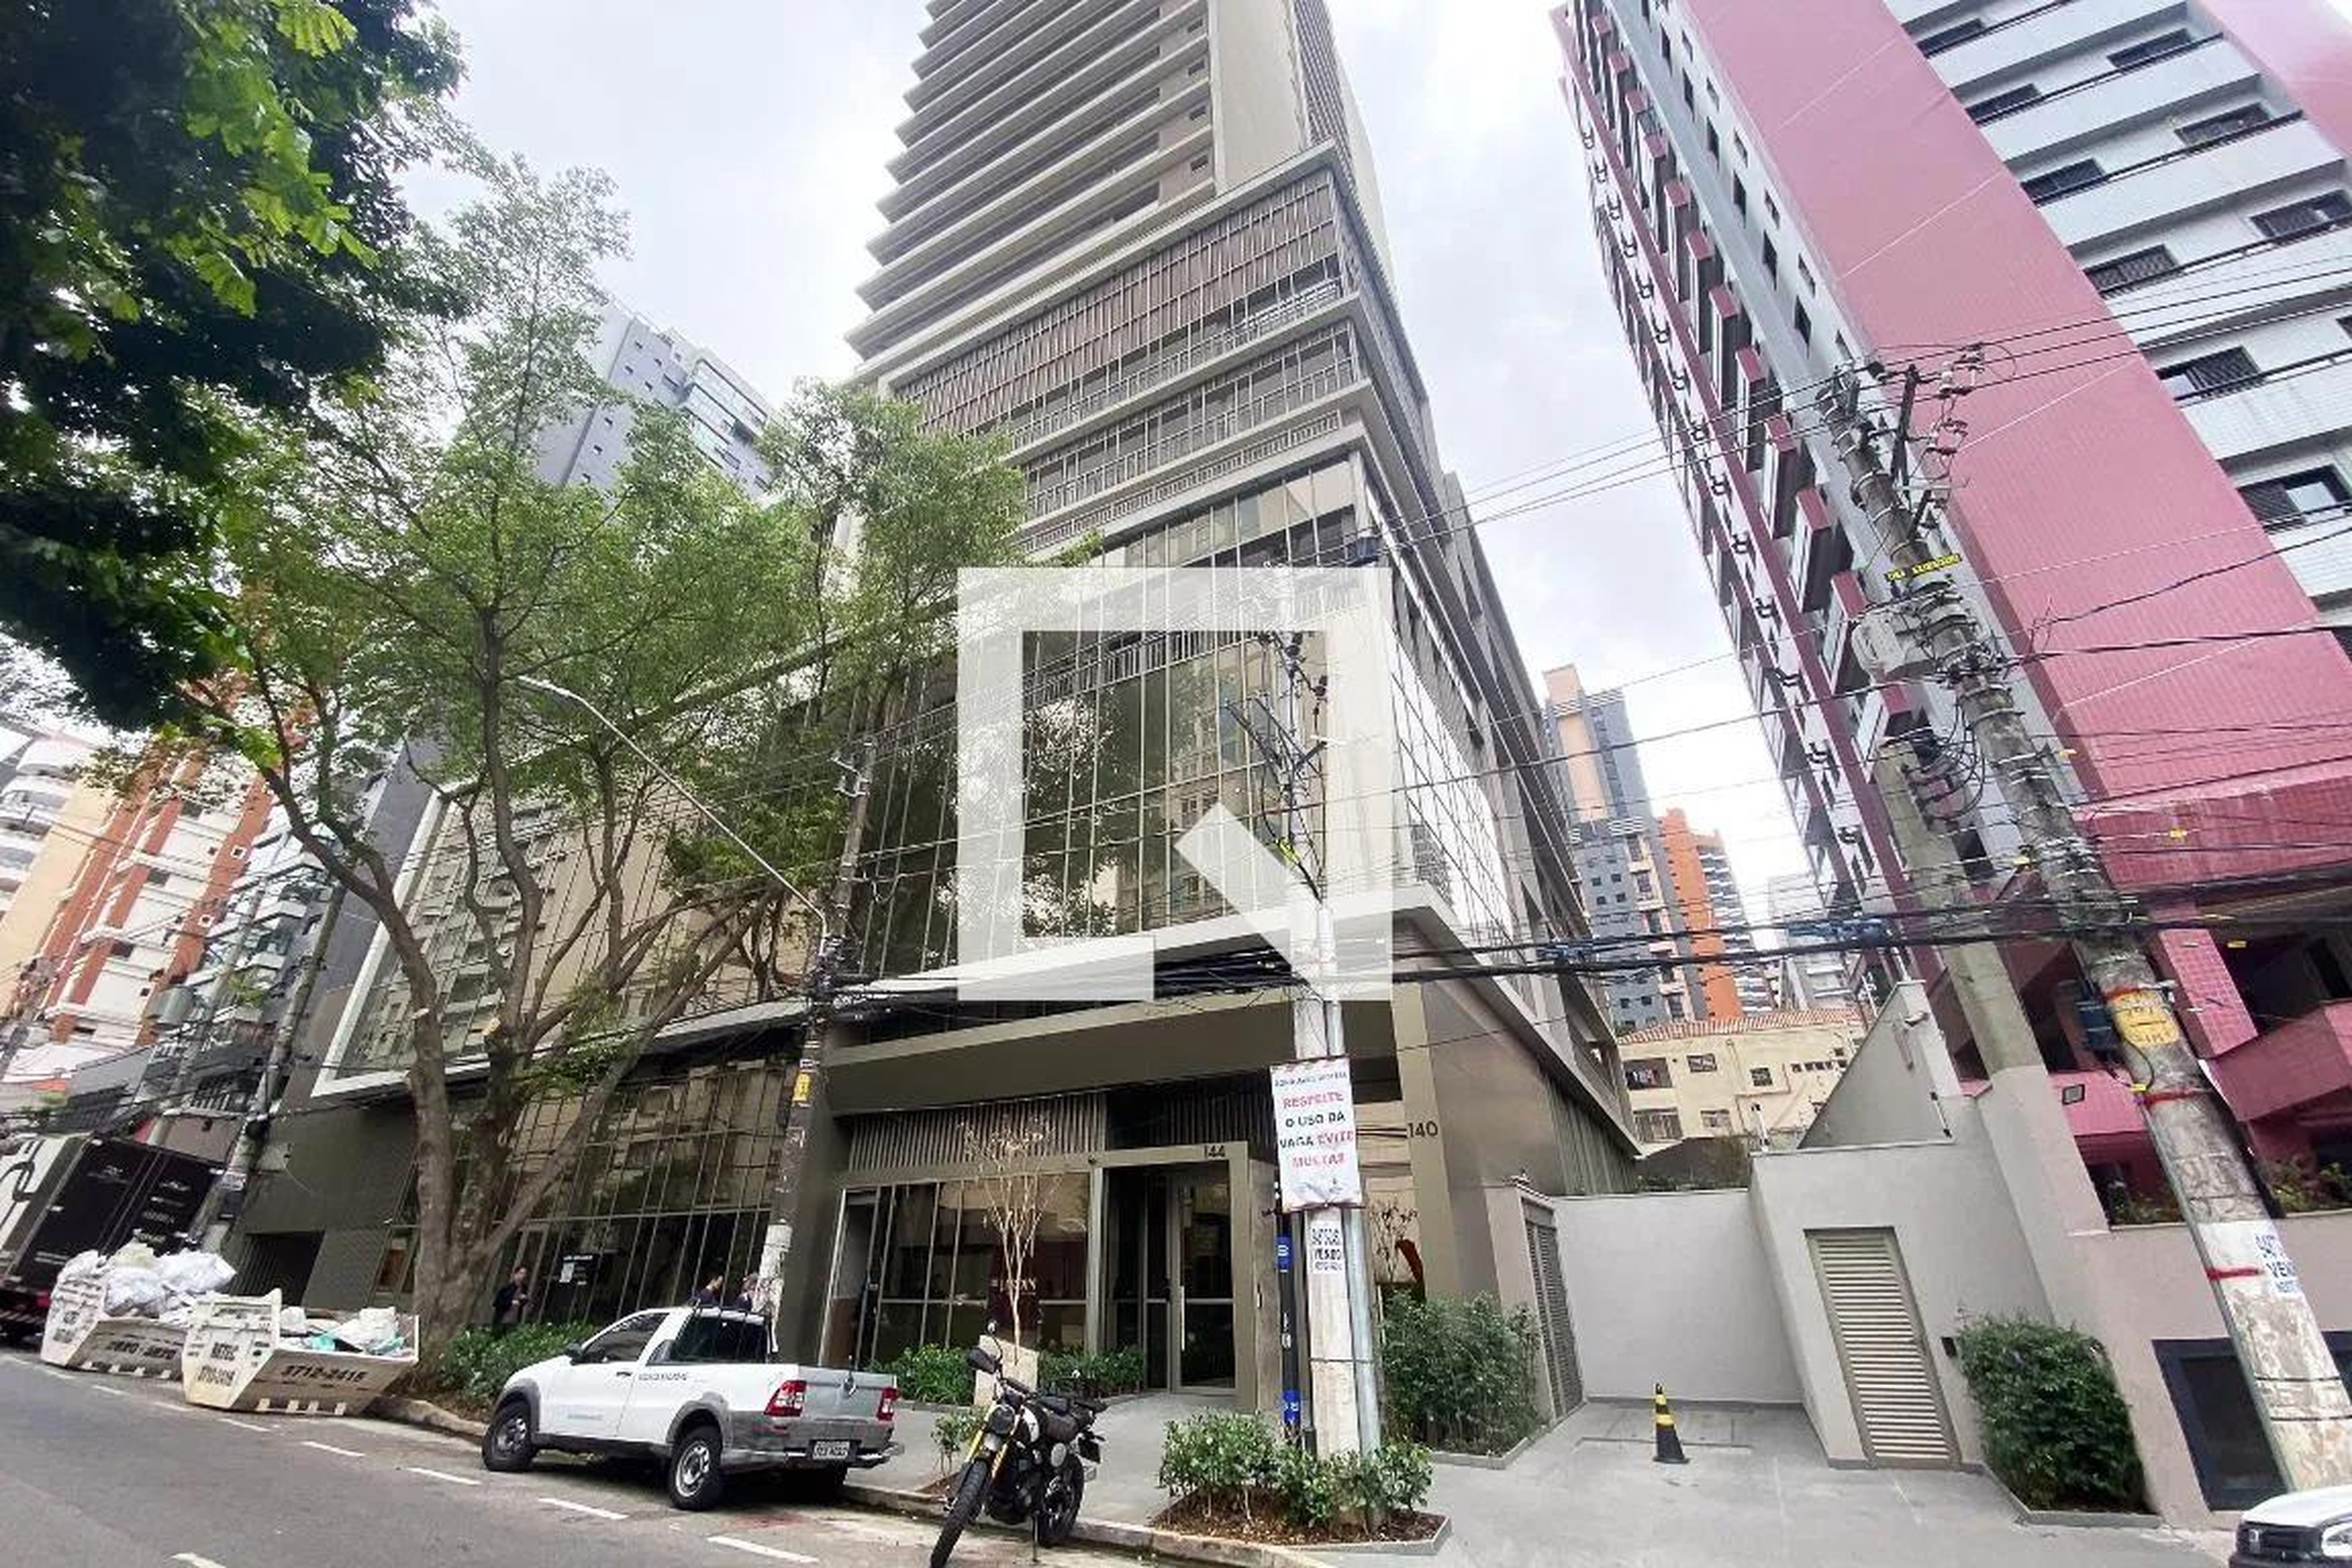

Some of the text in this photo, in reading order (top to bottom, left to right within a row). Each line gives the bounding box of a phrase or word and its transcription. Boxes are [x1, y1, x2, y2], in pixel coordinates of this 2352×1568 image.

[1283, 1091, 1344, 1109] RESPEITE
[1285, 1111, 1346, 1128] O USO DA
[1408, 1121, 1438, 1137] 140
[1280, 1136, 1314, 1148] VAGA
[1204, 1145, 1226, 1158] 144
